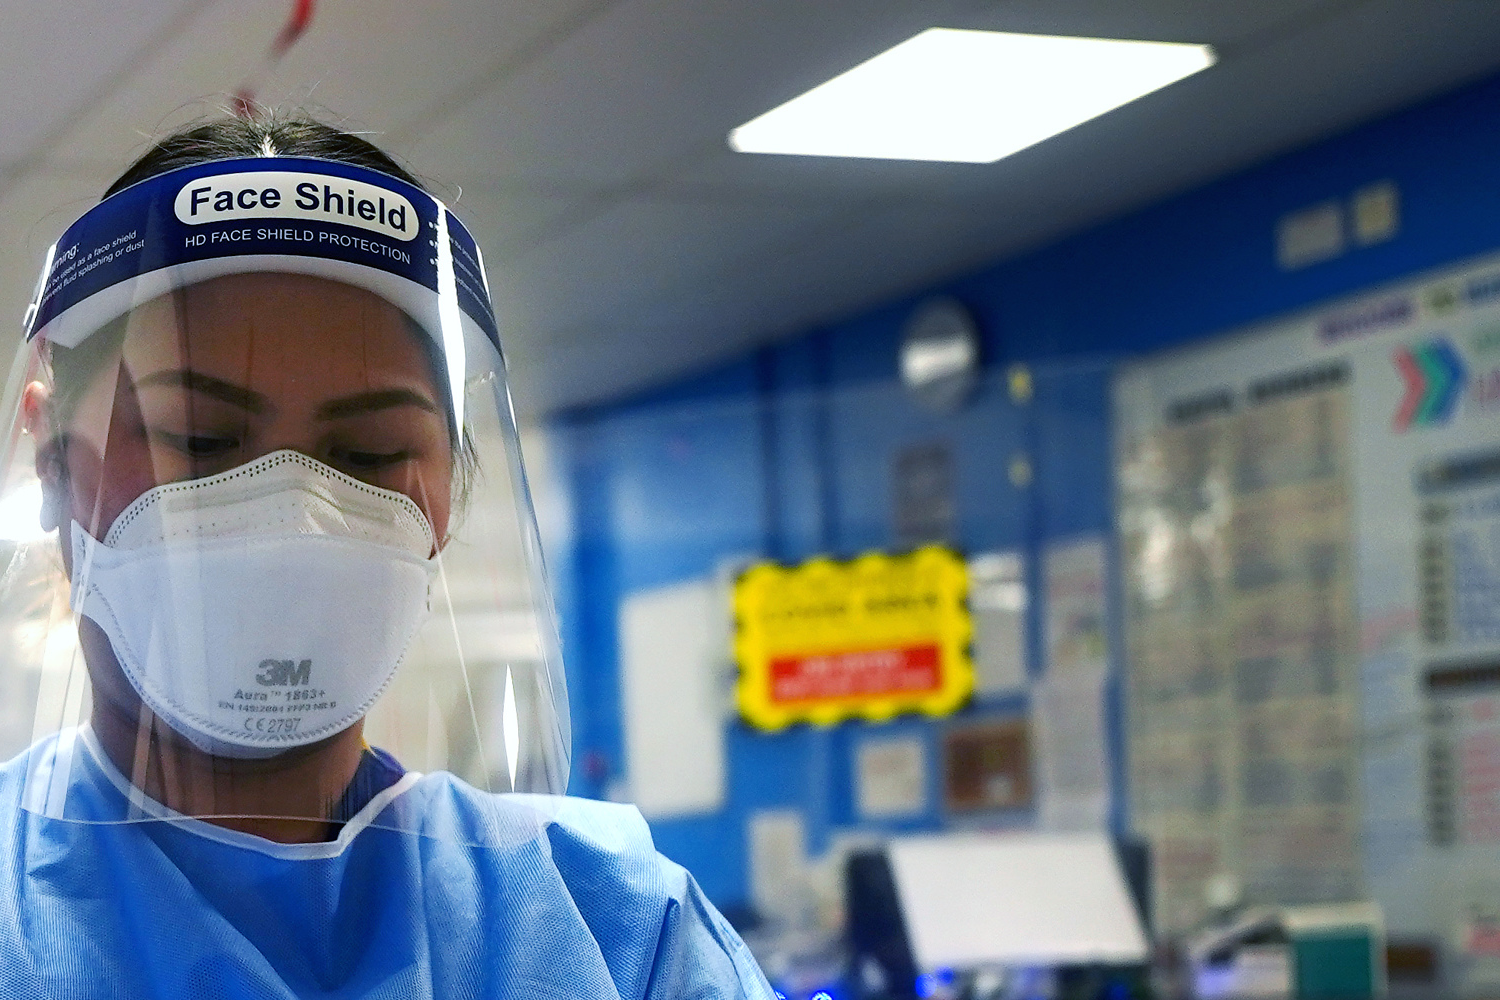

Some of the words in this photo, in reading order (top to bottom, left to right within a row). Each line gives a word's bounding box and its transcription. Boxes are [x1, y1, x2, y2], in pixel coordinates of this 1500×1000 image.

[191, 185, 281, 216] Face
[295, 182, 407, 232] Shield
[78, 253, 114, 278] splashing
[115, 248, 125, 258] or
[125, 240, 146, 255] dust
[93, 243, 112, 258] face
[112, 229, 138, 248] shield
[185, 234, 207, 248] HD
[211, 229, 252, 243] FACE
[257, 228, 314, 242] SHIELD
[319, 231, 411, 265] PROTECTION
[255, 659, 312, 687] 3M
